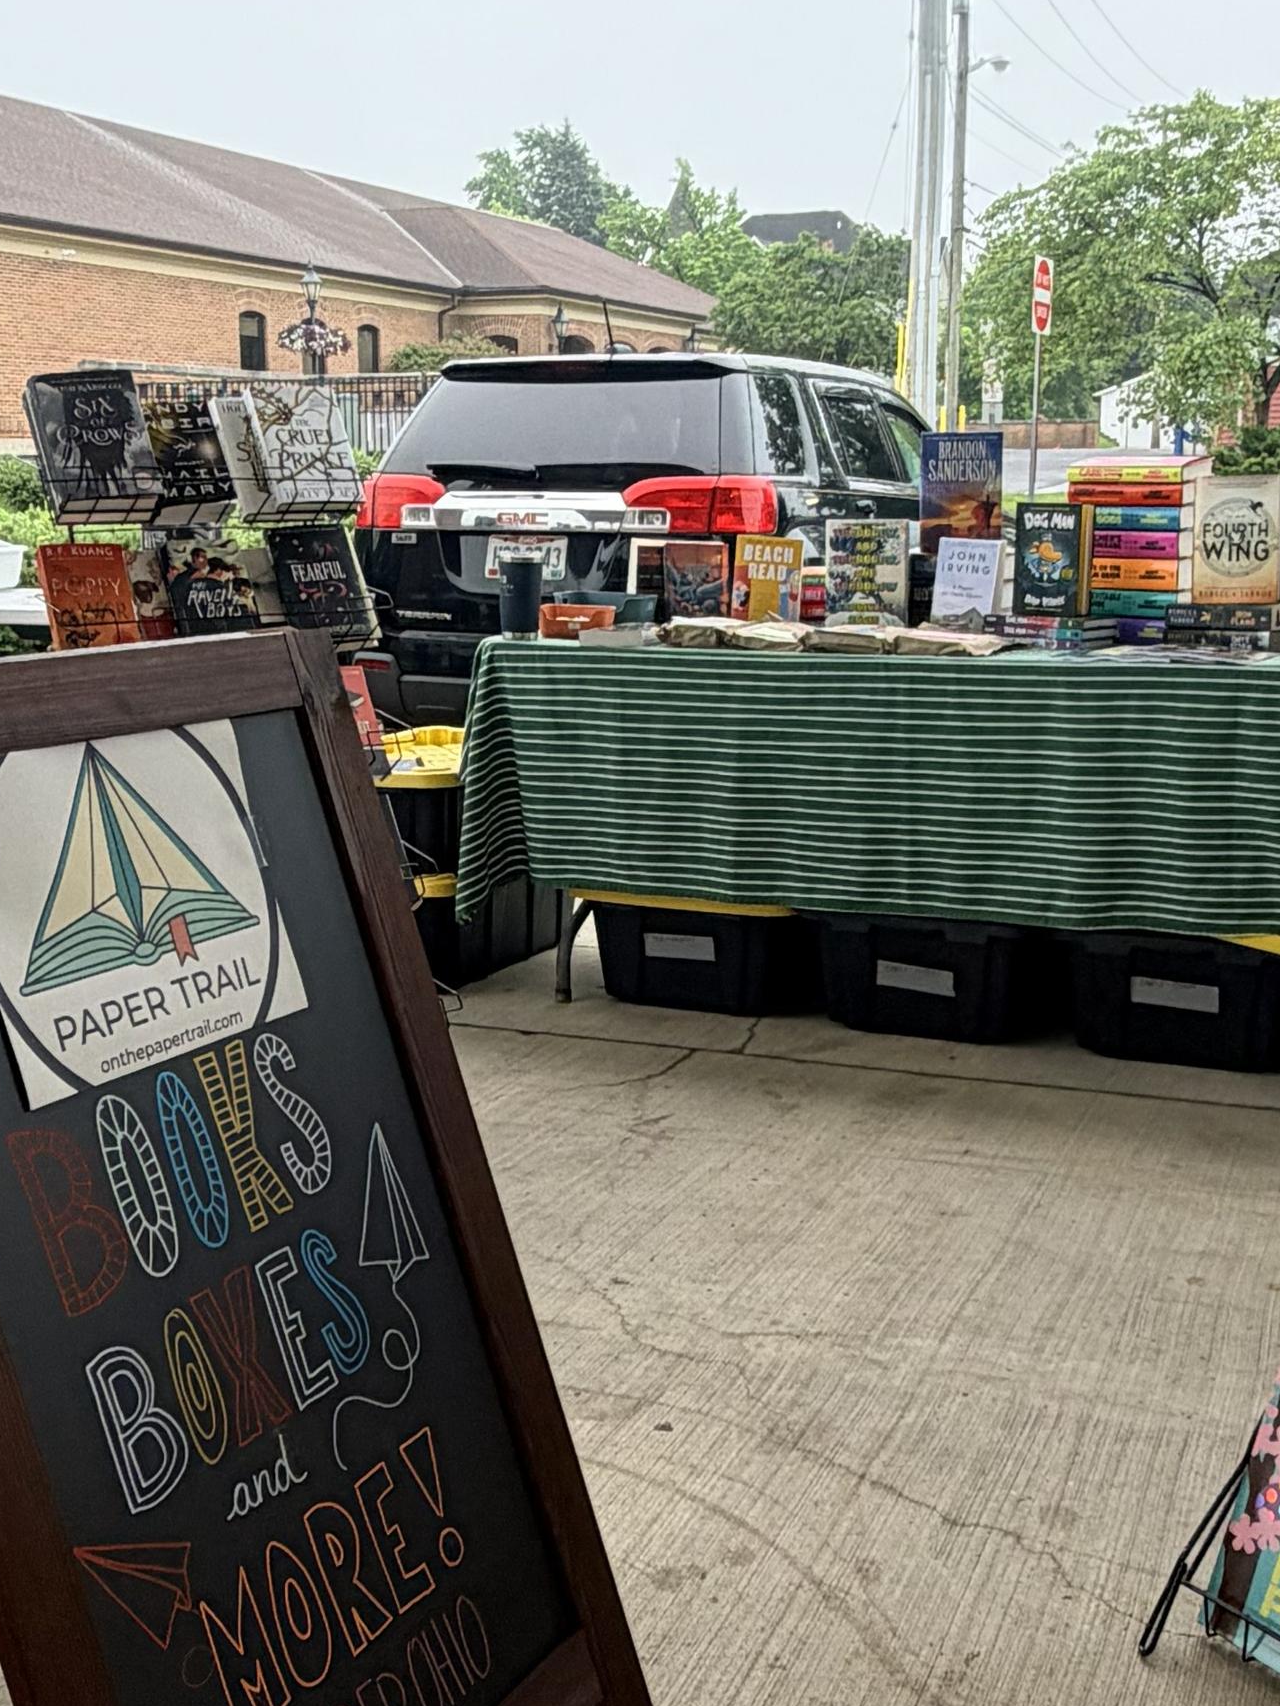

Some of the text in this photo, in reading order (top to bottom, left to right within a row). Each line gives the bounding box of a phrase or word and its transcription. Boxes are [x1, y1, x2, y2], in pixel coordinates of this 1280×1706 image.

[938, 441, 987, 459] BRANDON
[928, 459, 997, 482] SANDERSON
[497, 512, 549, 525] GMC
[1024, 512, 1049, 530] DOG
[1051, 512, 1075, 530] MAN
[1202, 522, 1269, 540] FOURTH
[742, 544, 794, 563] BEACH
[948, 551, 987, 563] JOHN
[1202, 539, 1270, 562] WING
[290, 561, 347, 583] FEARFUL
[747, 564, 787, 581] READ
[942, 564, 991, 575] IRVING
[53, 957, 262, 1053] PAPER TRAIL
[100, 1011, 244, 1075] onthepapertrail.com
[5, 1032, 332, 1317] BOOKS
[86, 1229, 370, 1515] BOXES
[226, 1433, 308, 1522] and
